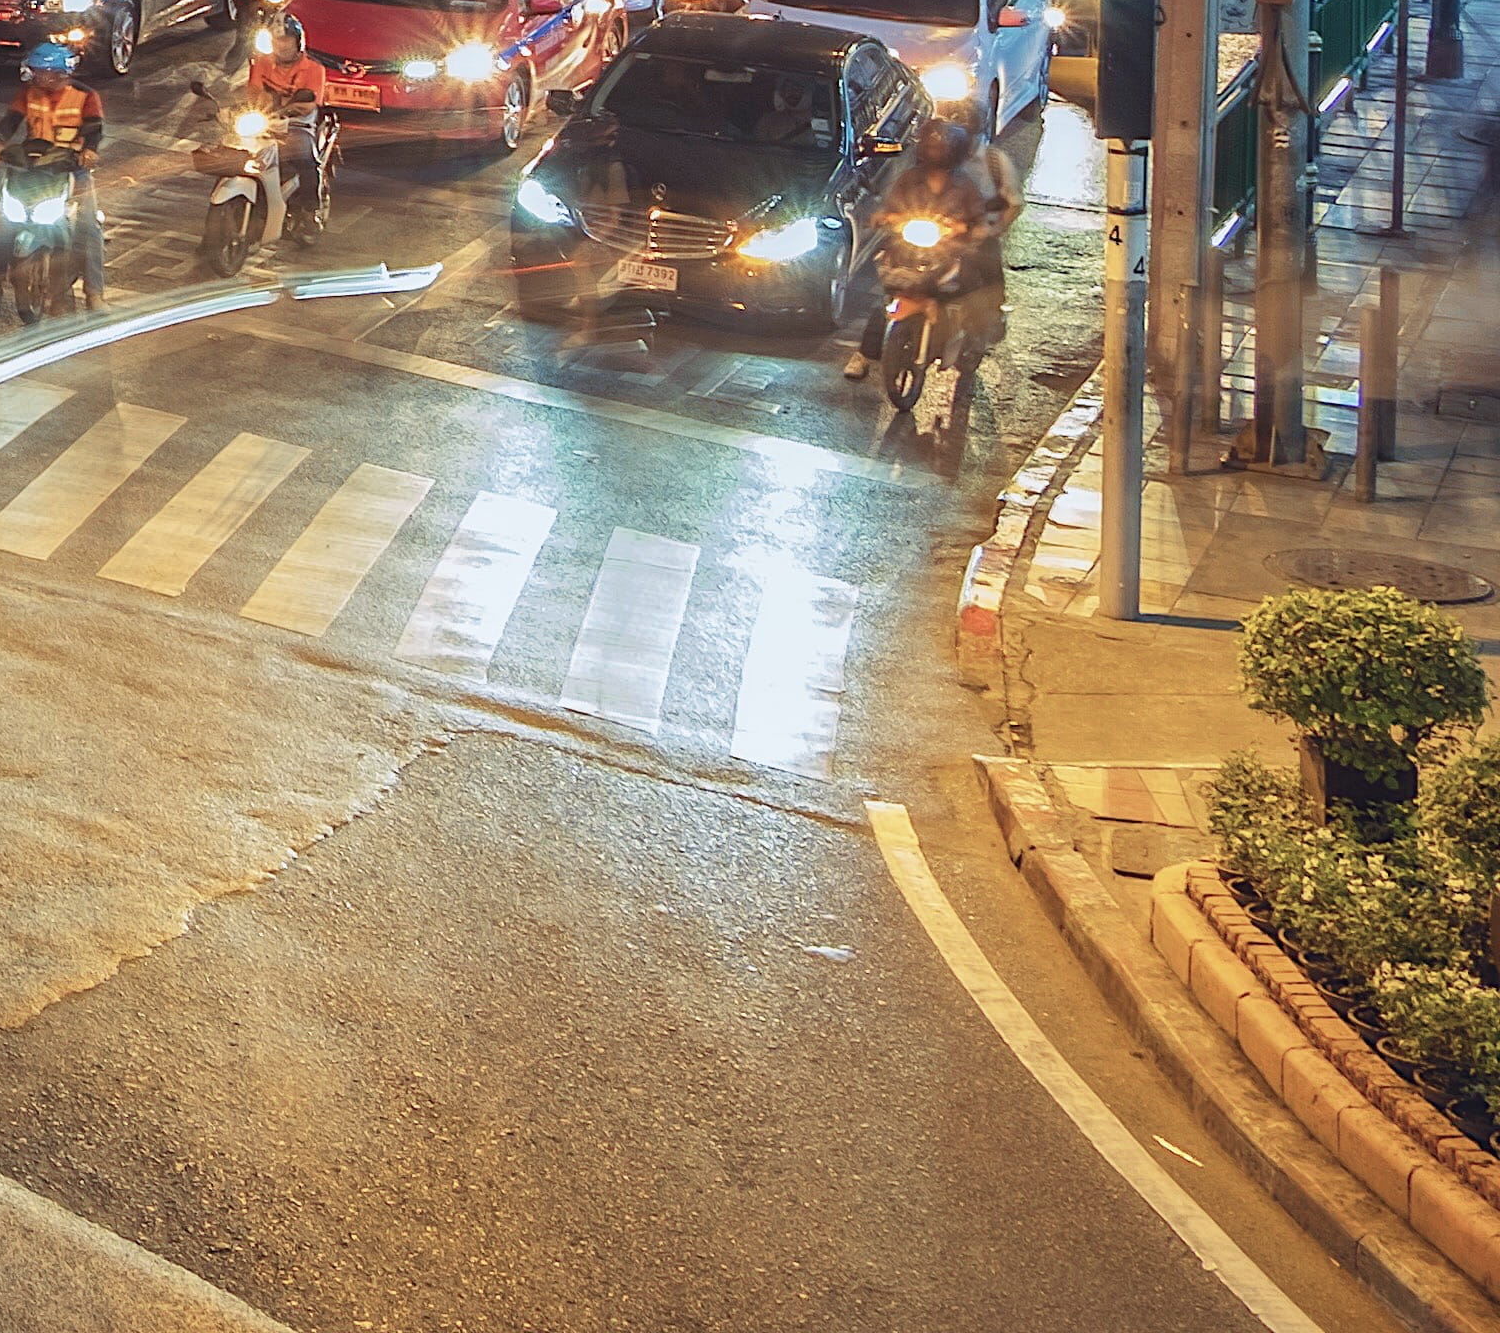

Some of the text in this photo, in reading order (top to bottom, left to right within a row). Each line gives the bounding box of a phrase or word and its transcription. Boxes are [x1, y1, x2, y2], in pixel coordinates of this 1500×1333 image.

[1109, 225, 1123, 245] 4
[647, 266, 675, 281] 7392
[1133, 255, 1145, 277] 4
